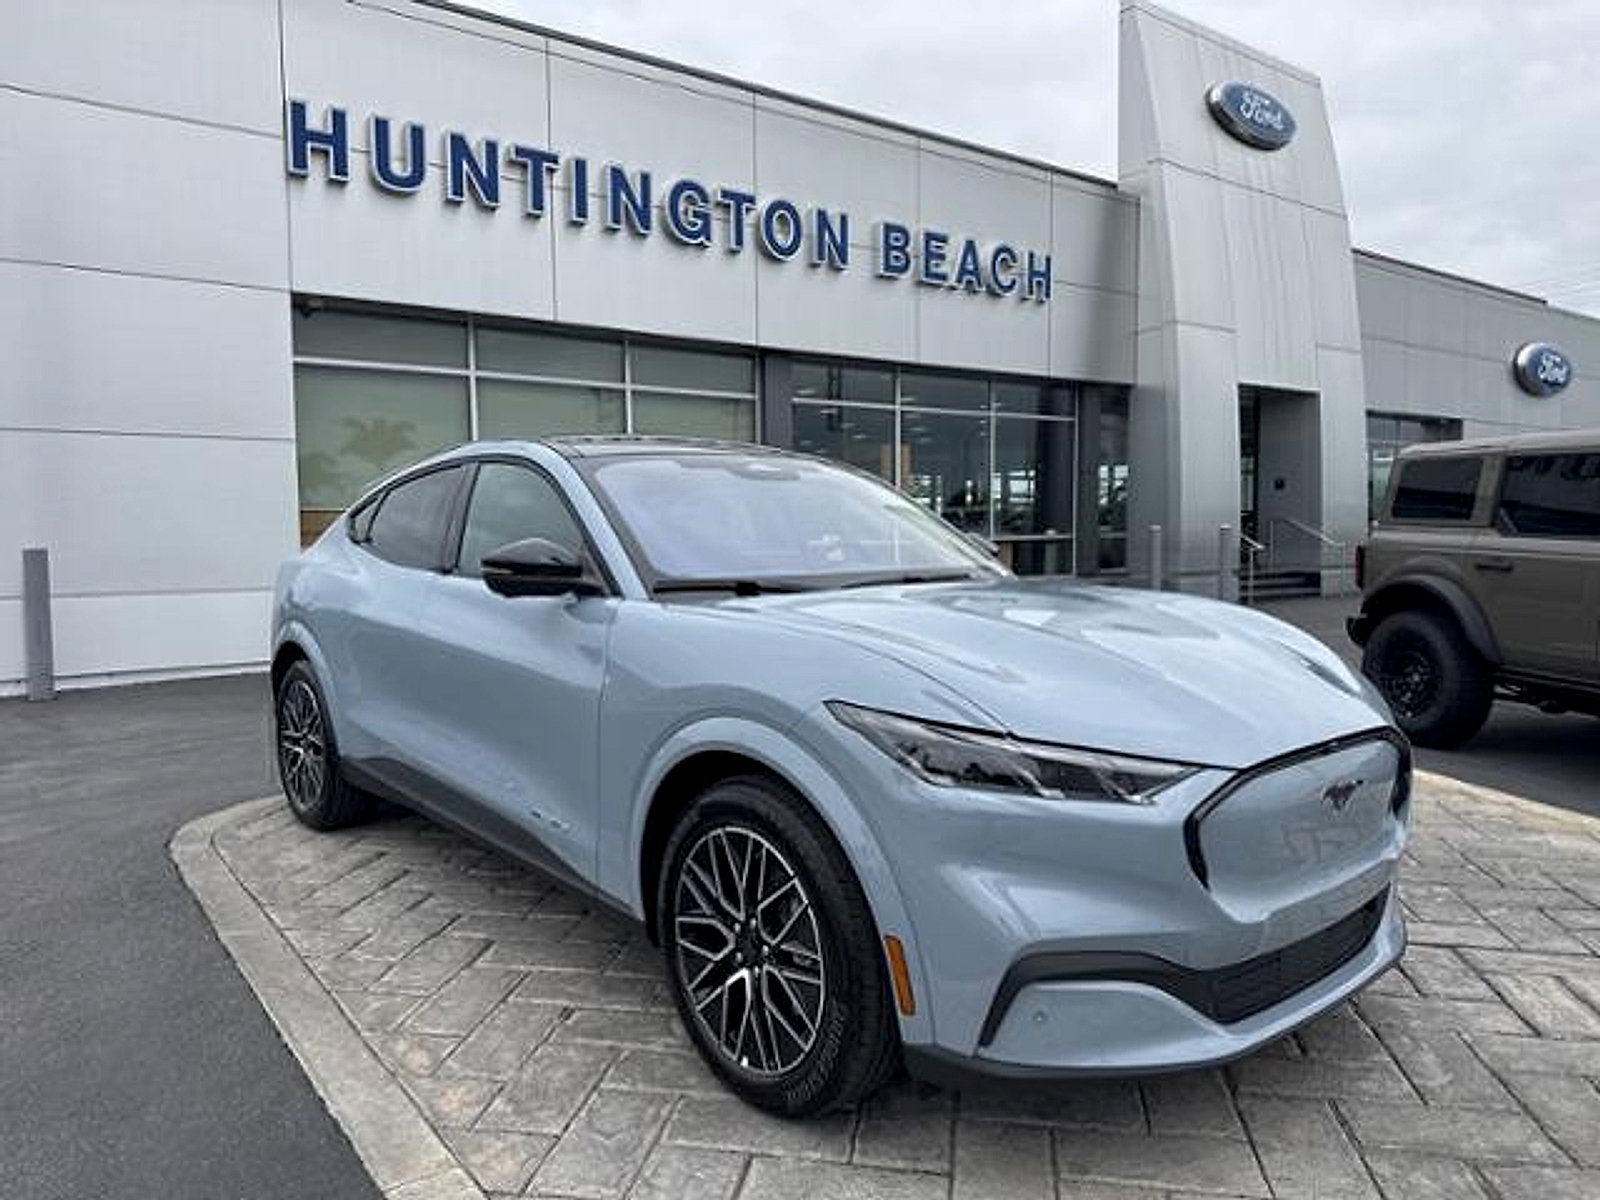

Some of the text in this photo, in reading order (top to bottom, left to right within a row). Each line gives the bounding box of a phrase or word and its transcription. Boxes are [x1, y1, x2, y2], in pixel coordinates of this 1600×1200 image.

[1239, 89, 1286, 131] Ford
[287, 98, 1052, 302] HUNTINGTON BEACH
[1537, 352, 1568, 384] Ford
